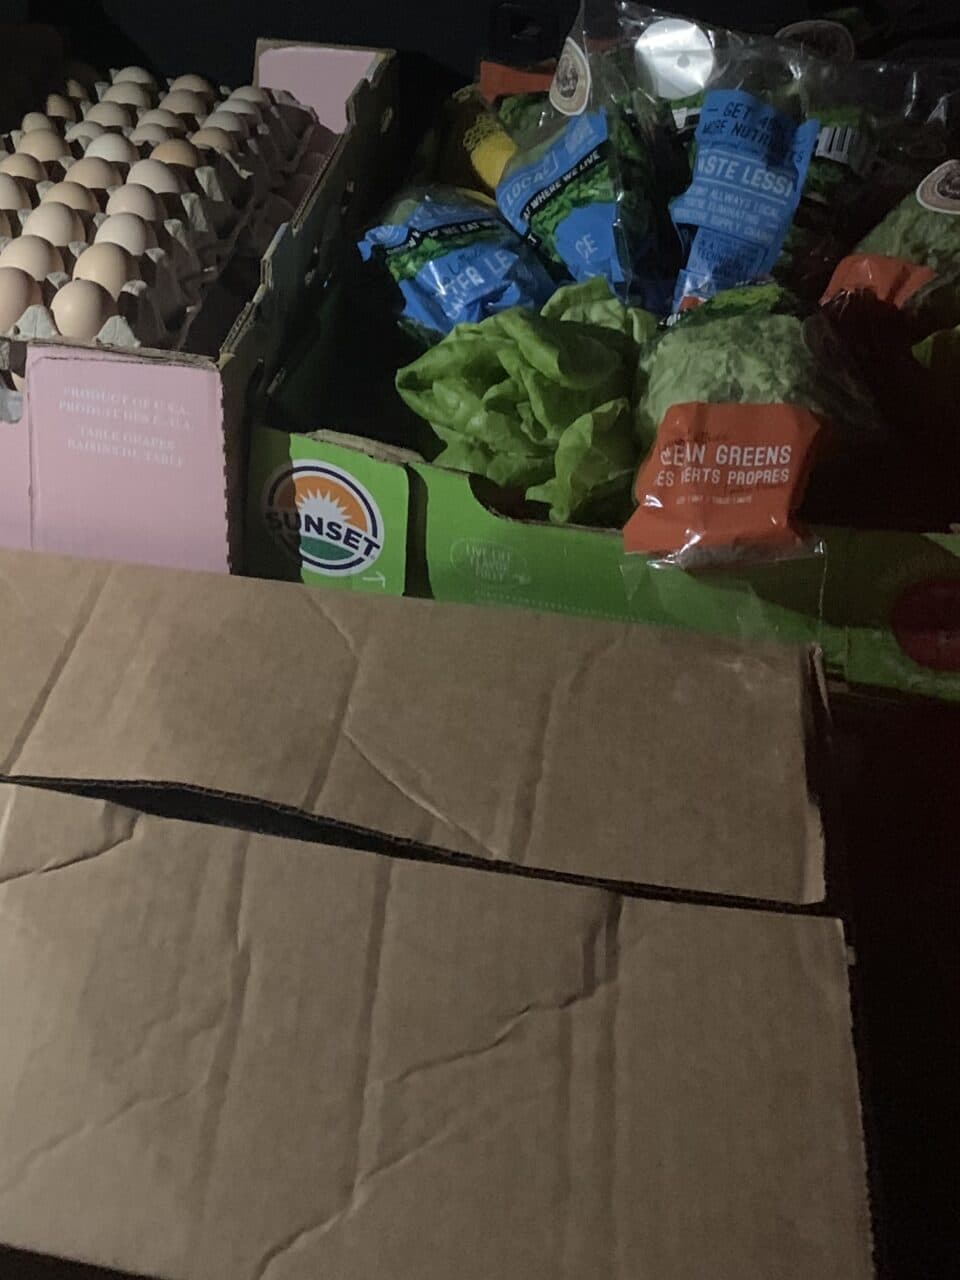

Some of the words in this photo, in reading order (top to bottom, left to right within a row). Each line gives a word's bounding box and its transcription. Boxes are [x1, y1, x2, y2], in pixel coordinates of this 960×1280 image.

[697, 155, 739, 180] STE
[715, 444, 793, 467] GREENS
[727, 468, 791, 486] PROPRES
[265, 511, 380, 557] SUNSET
